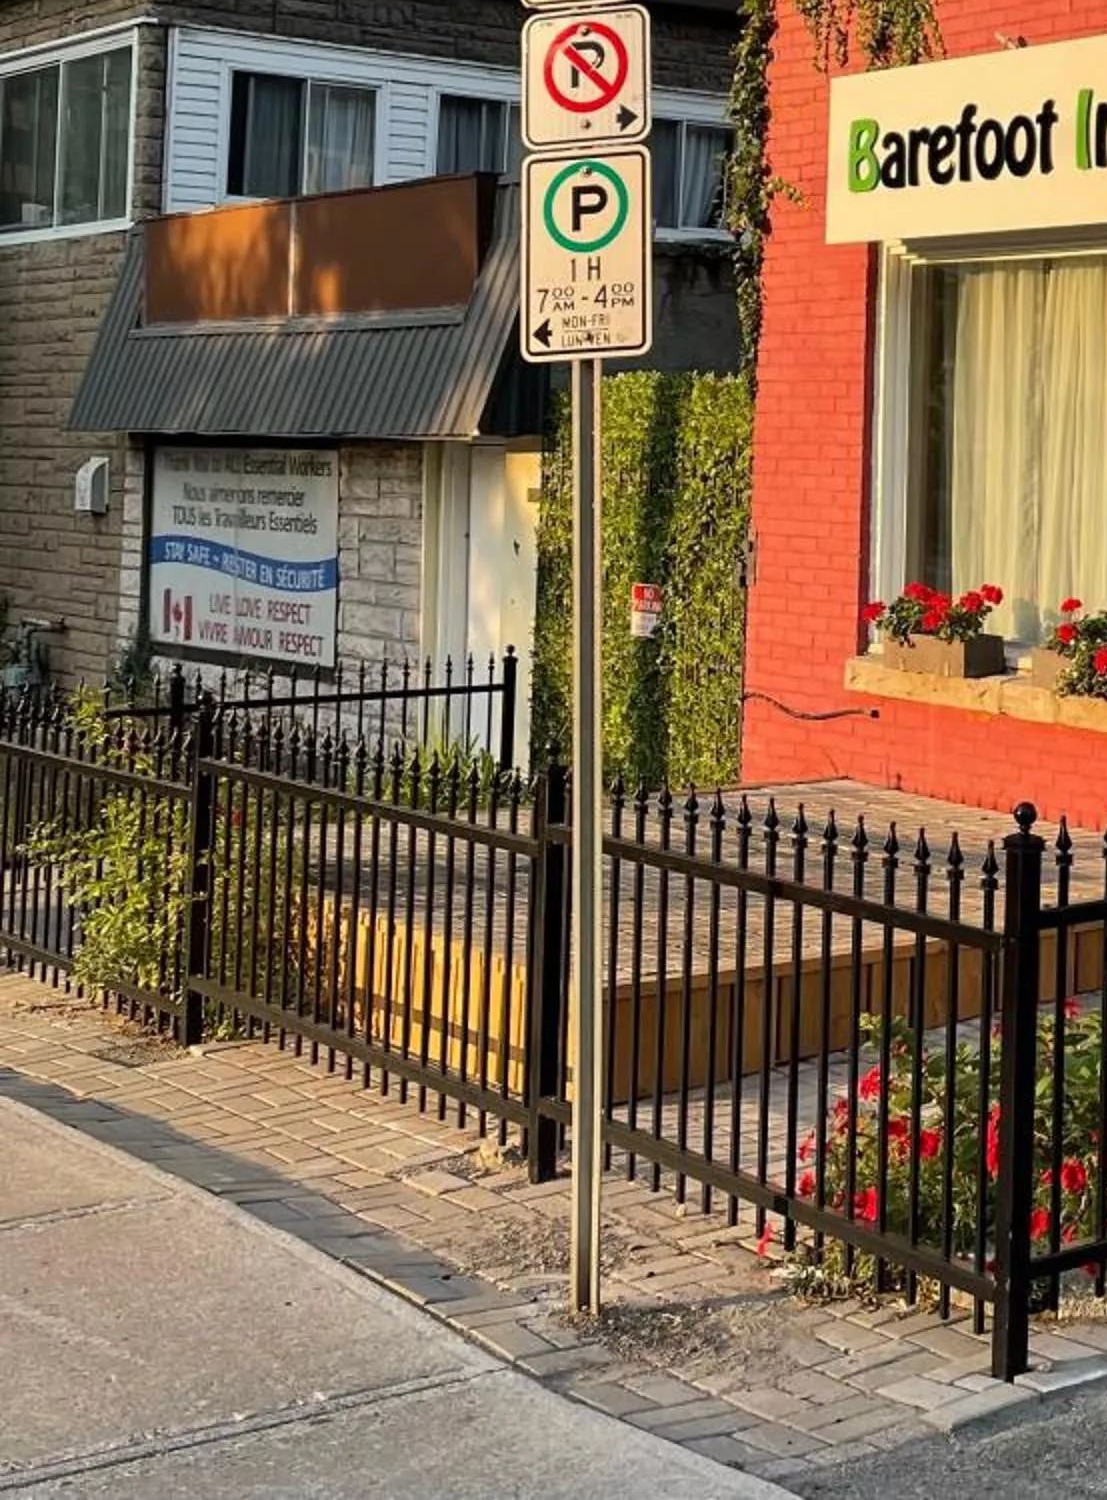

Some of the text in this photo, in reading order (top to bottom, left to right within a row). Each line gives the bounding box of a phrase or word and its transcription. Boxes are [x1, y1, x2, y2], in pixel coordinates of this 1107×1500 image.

[848, 99, 1059, 193] Barefoot
[571, 185, 608, 232] P
[587, 255, 601, 281] H
[553, 297, 635, 312] AM PM
[561, 313, 611, 329] MON-FRI
[561, 331, 611, 348] LUNVEN
[244, 453, 286, 474] Essential
[289, 453, 332, 476] Workers
[164, 542, 184, 560] STAY
[187, 543, 210, 565] SAFE
[260, 564, 273, 585] EN
[209, 593, 312, 625] LIVE LOVE RESPECT
[199, 620, 324, 657] VIVRE AMOUR RESPECT
